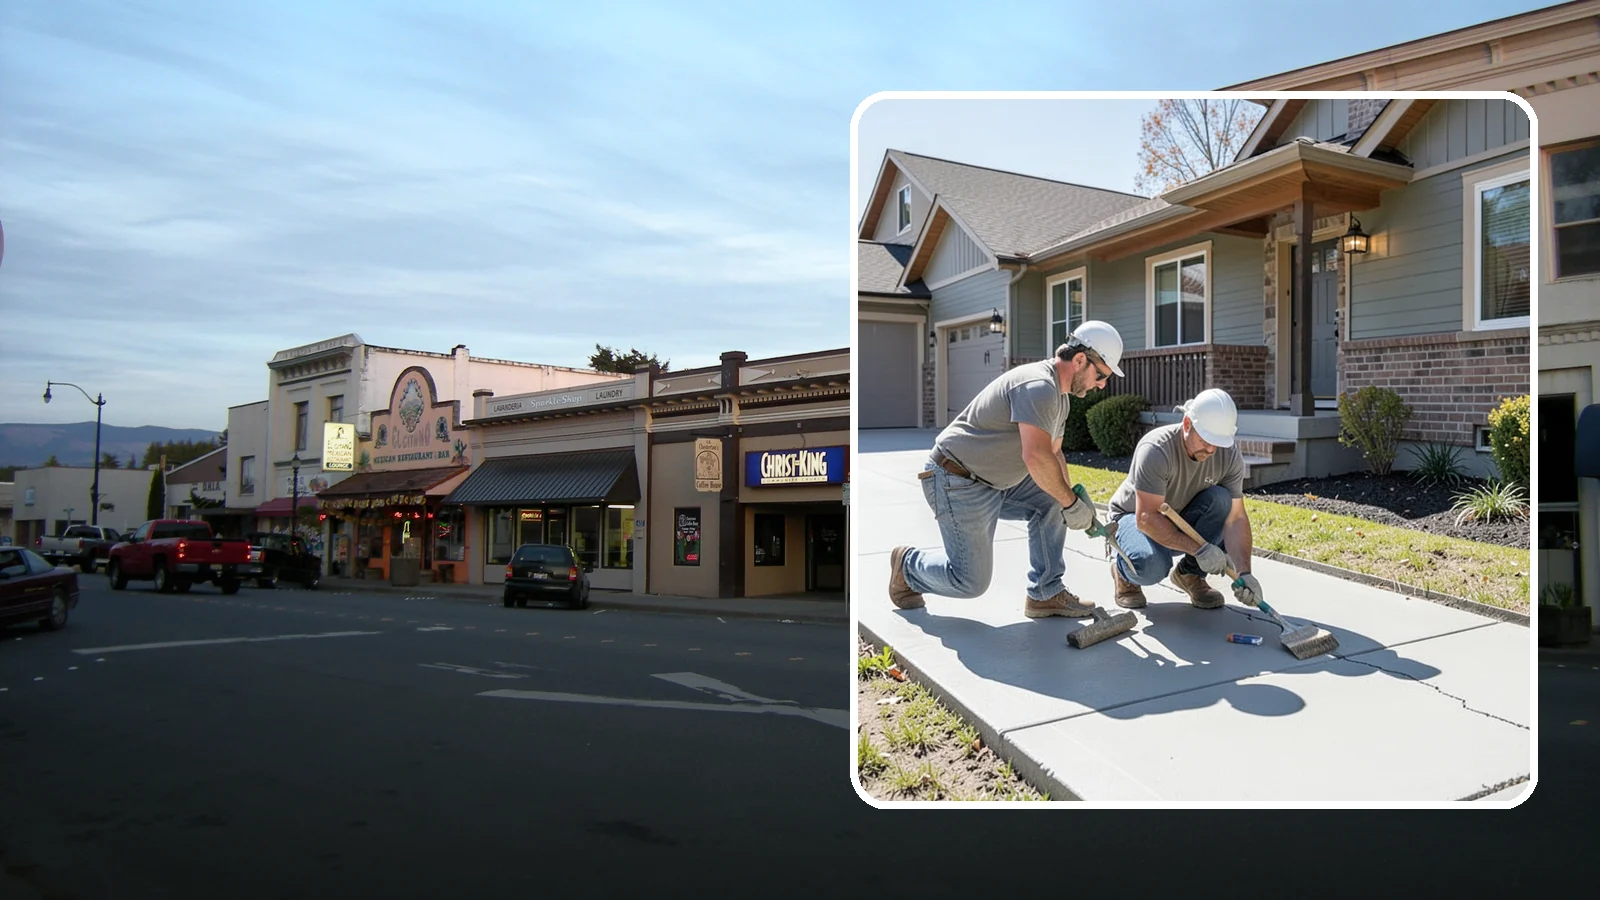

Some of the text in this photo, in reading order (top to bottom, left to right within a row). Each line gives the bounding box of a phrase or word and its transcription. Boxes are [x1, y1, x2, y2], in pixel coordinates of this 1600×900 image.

[595, 389, 623, 399] LAUNDRY
[493, 402, 523, 413] LAVANDERIA
[373, 455, 396, 464] MEXICAN
[397, 451, 434, 462] RESTAURANT
[437, 450, 450, 459] BAR
[761, 449, 827, 478] CHRIST KING
[696, 480, 722, 489] Coffee House
